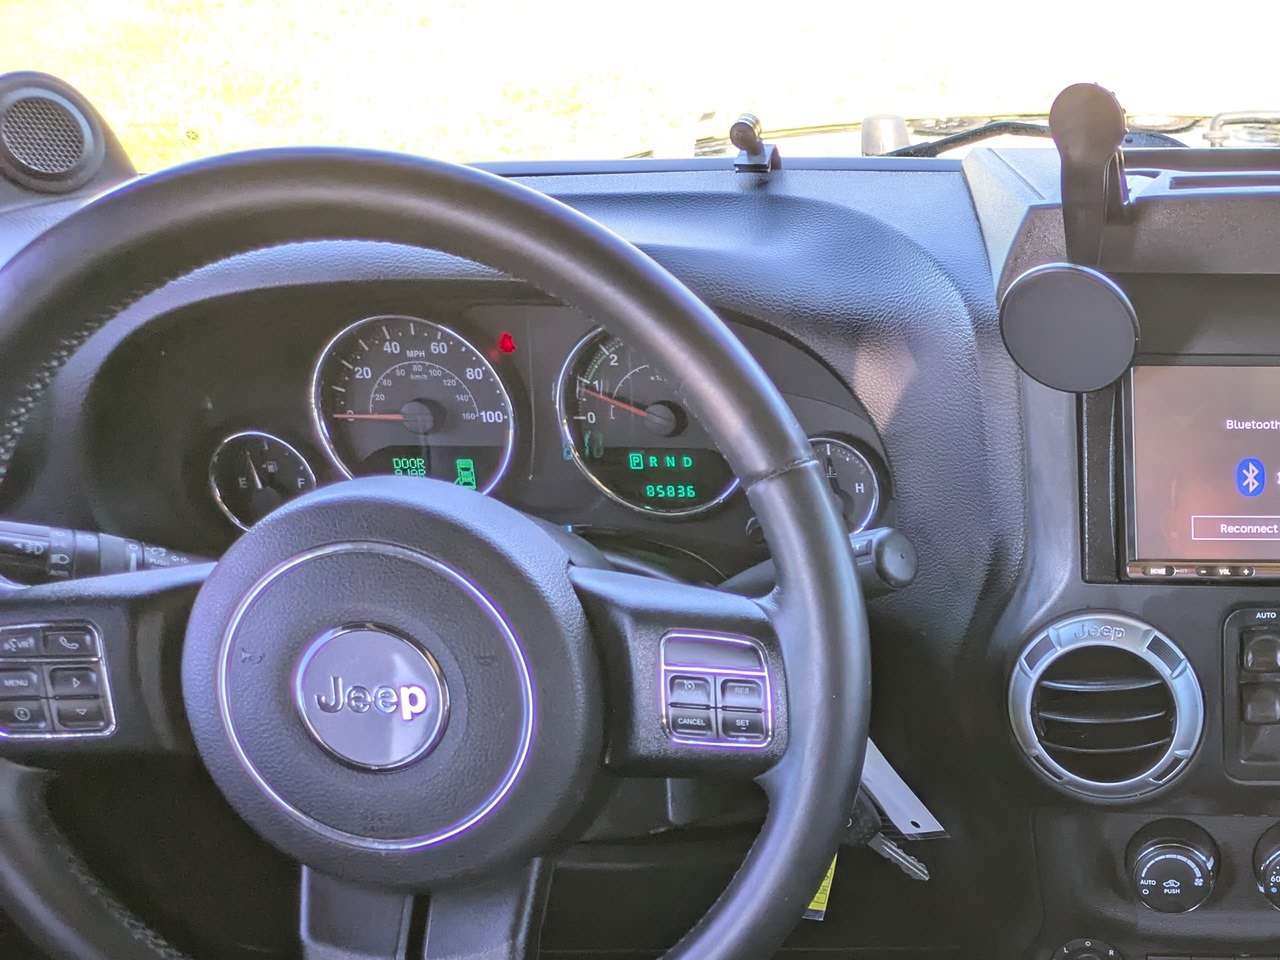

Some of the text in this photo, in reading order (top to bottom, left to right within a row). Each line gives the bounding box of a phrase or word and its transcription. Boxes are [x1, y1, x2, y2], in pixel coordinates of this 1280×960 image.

[383, 341, 400, 354] 40
[430, 341, 448, 354] 60
[406, 350, 425, 358] MPH
[608, 354, 619, 366] 2
[354, 367, 372, 379] 20
[465, 367, 483, 380] 80
[480, 411, 504, 423] 100
[587, 412, 596, 424] 0
[393, 458, 425, 469] DOOR
[649, 456, 658, 467] R
[666, 455, 676, 467] N
[682, 456, 693, 468] D
[238, 477, 248, 489] E
[297, 478, 305, 489] F
[855, 483, 865, 493] H
[1220, 524, 1279, 534] Reconnect
[1255, 611, 1277, 619] AUTO
[1072, 623, 1127, 641] Jeep
[314, 676, 427, 721] Jeep
[678, 717, 706, 726] CANCEL
[735, 719, 750, 727] SET
